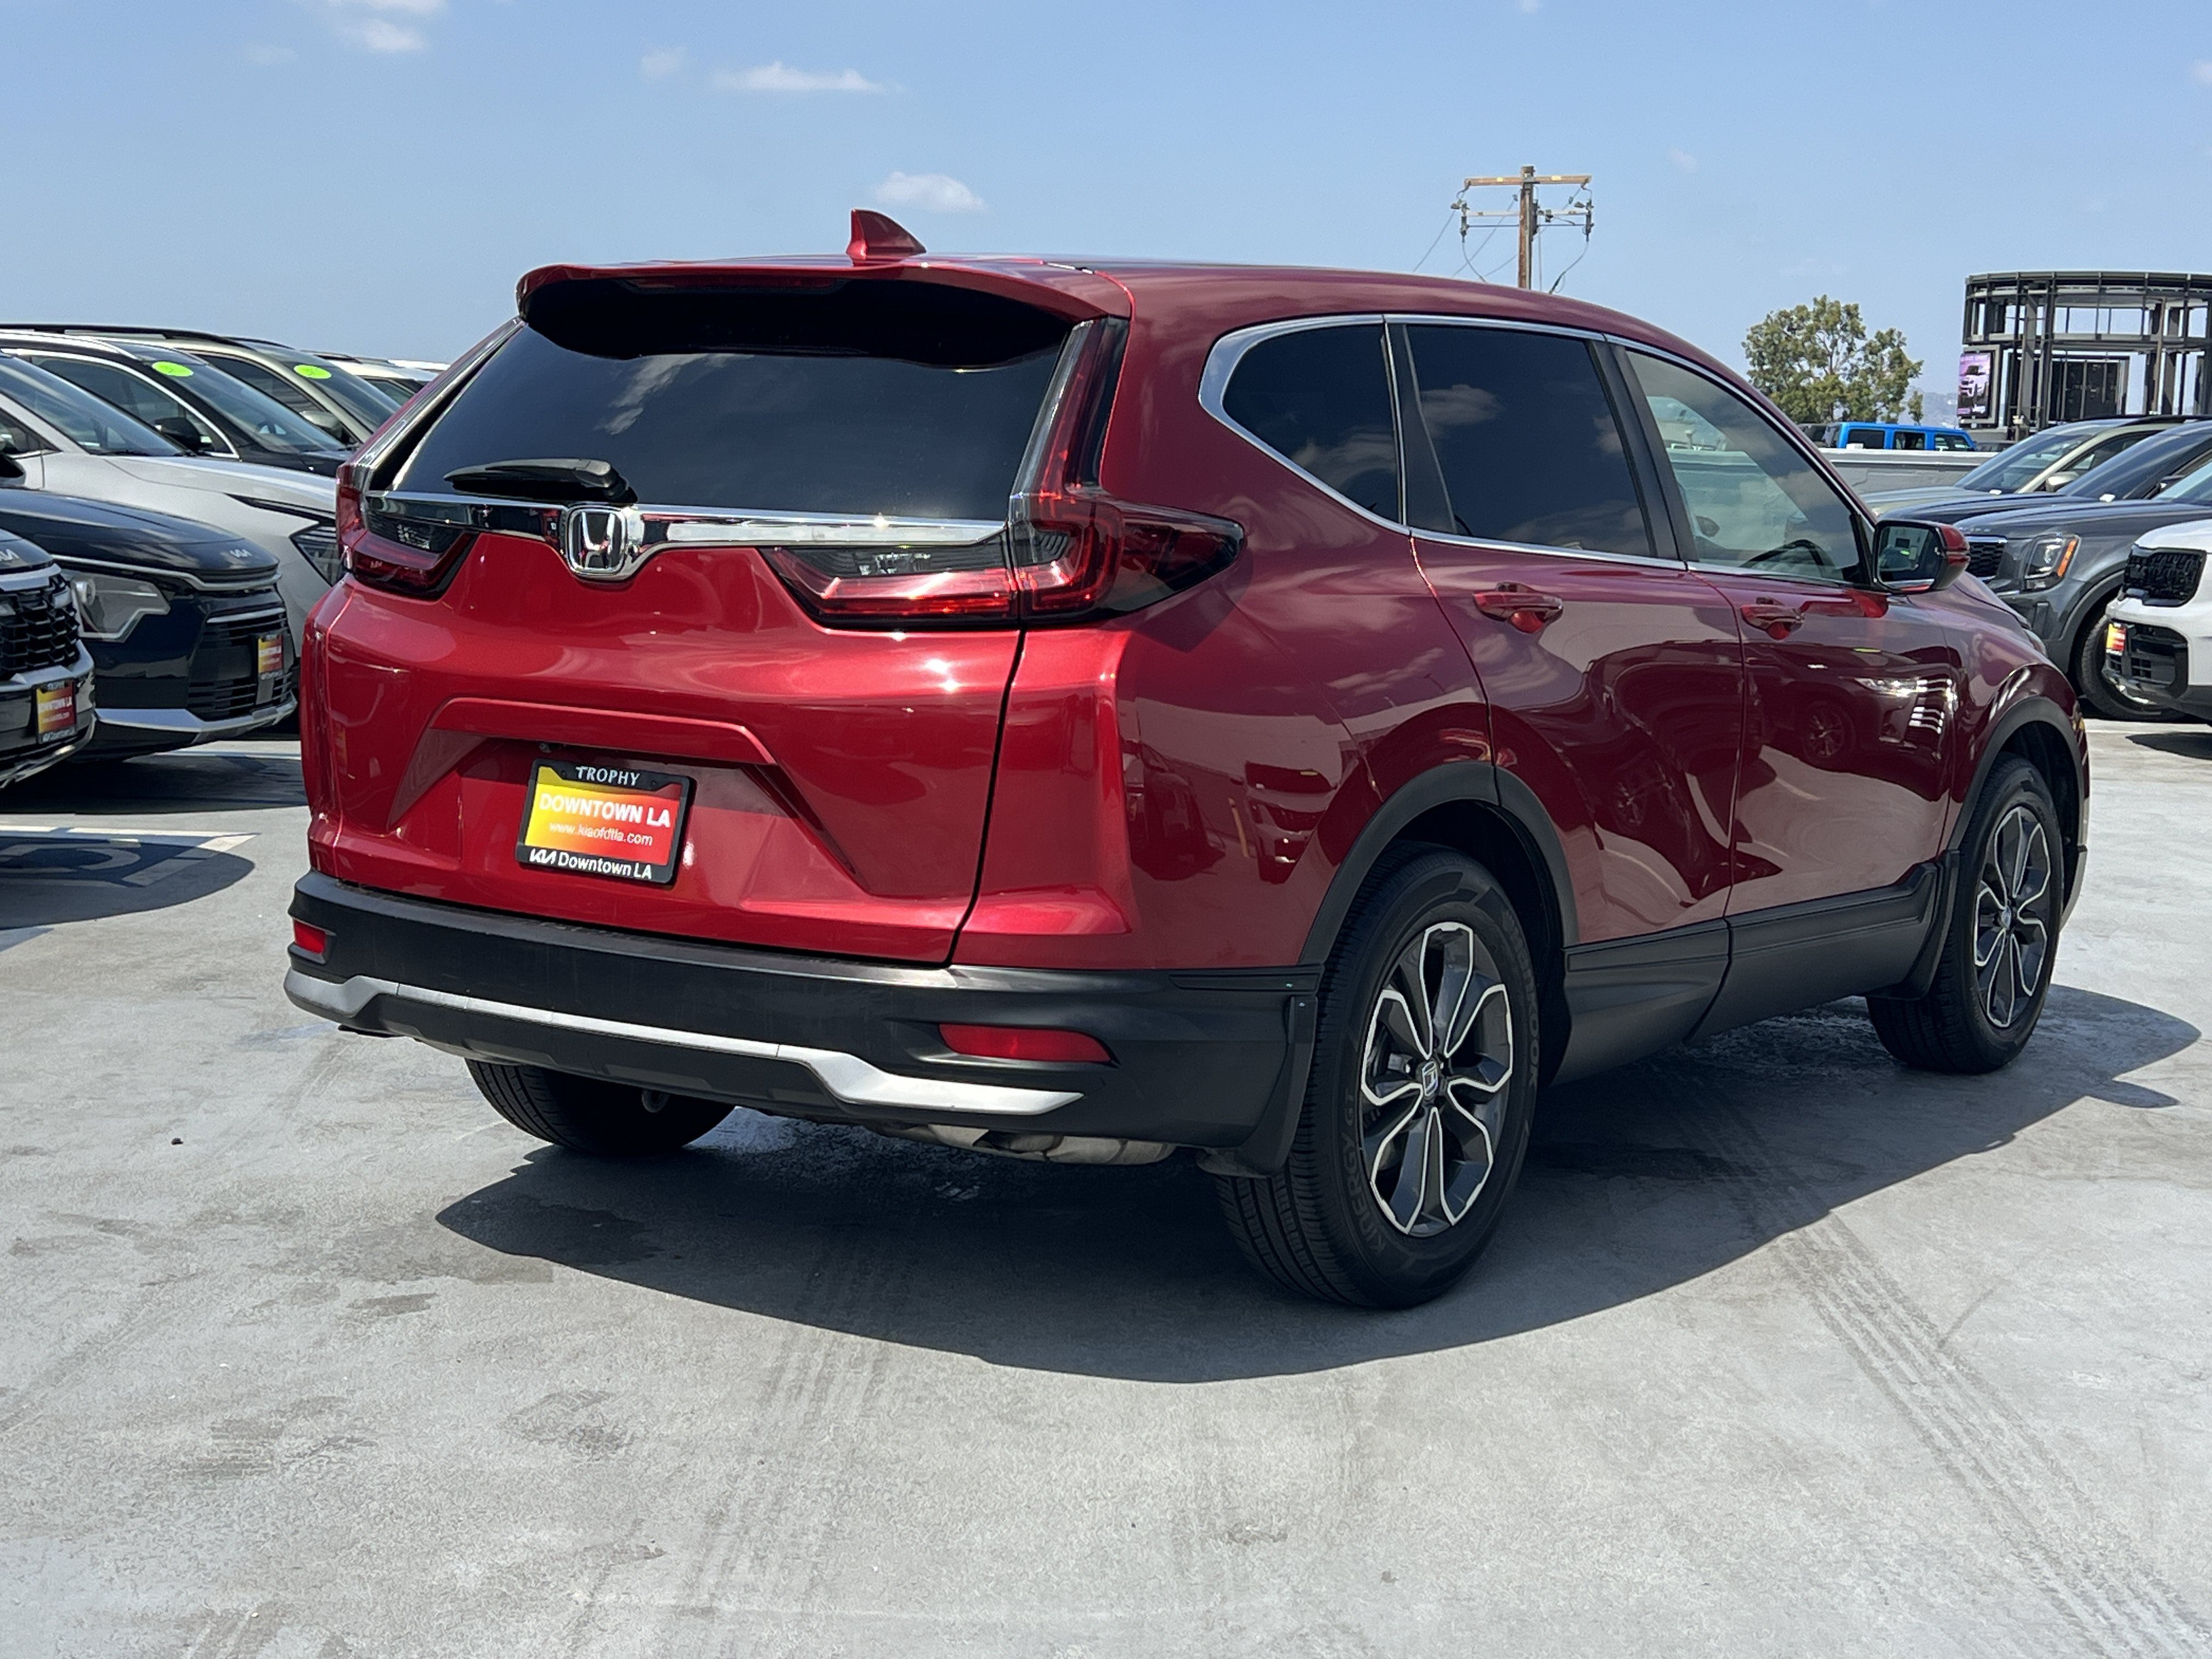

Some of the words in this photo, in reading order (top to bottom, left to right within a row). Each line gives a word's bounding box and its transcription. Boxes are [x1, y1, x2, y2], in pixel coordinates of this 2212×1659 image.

[575, 766, 640, 786] TROPHY
[539, 793, 644, 823] DOWNTOWN
[647, 807, 670, 828] LA
[529, 848, 556, 864] KIA
[558, 851, 632, 877] Downtown
[634, 862, 652, 879] LA
